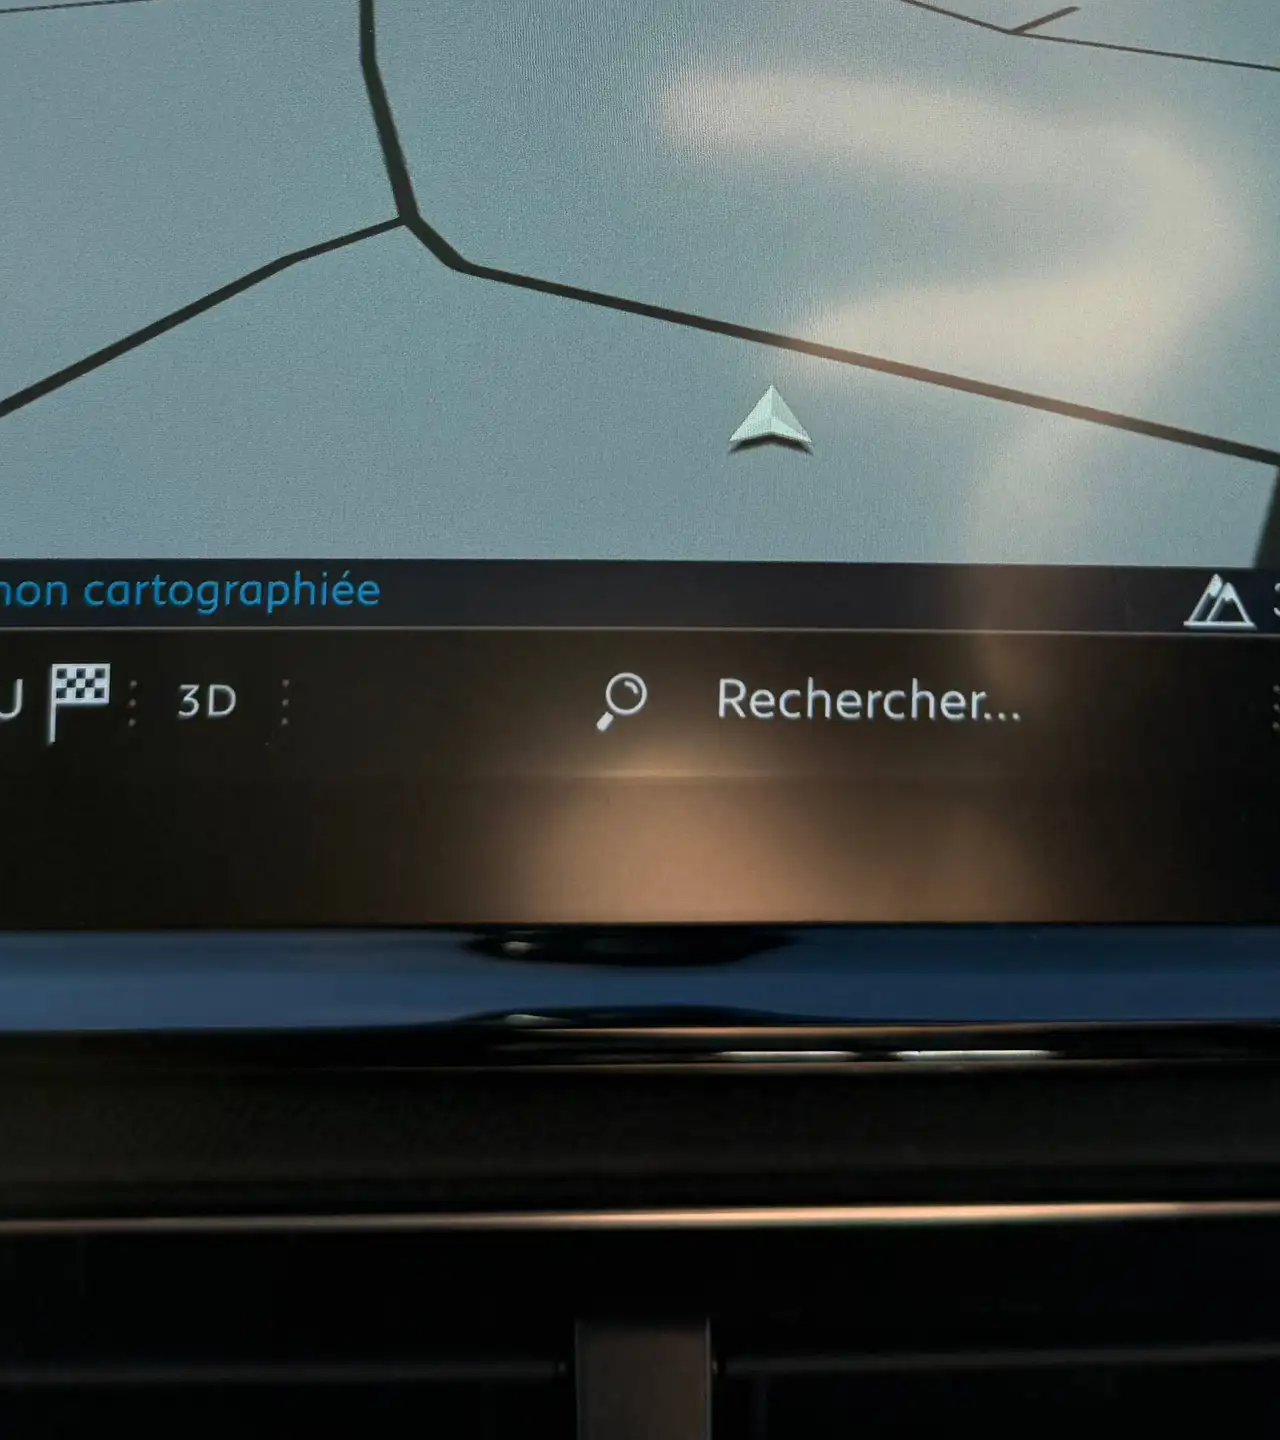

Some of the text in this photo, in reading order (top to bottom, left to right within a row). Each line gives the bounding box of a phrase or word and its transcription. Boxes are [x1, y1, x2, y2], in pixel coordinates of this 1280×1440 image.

[82, 570, 382, 616] cartographiée
[177, 683, 238, 719] 3D
[717, 676, 1022, 721] Rechercher...
